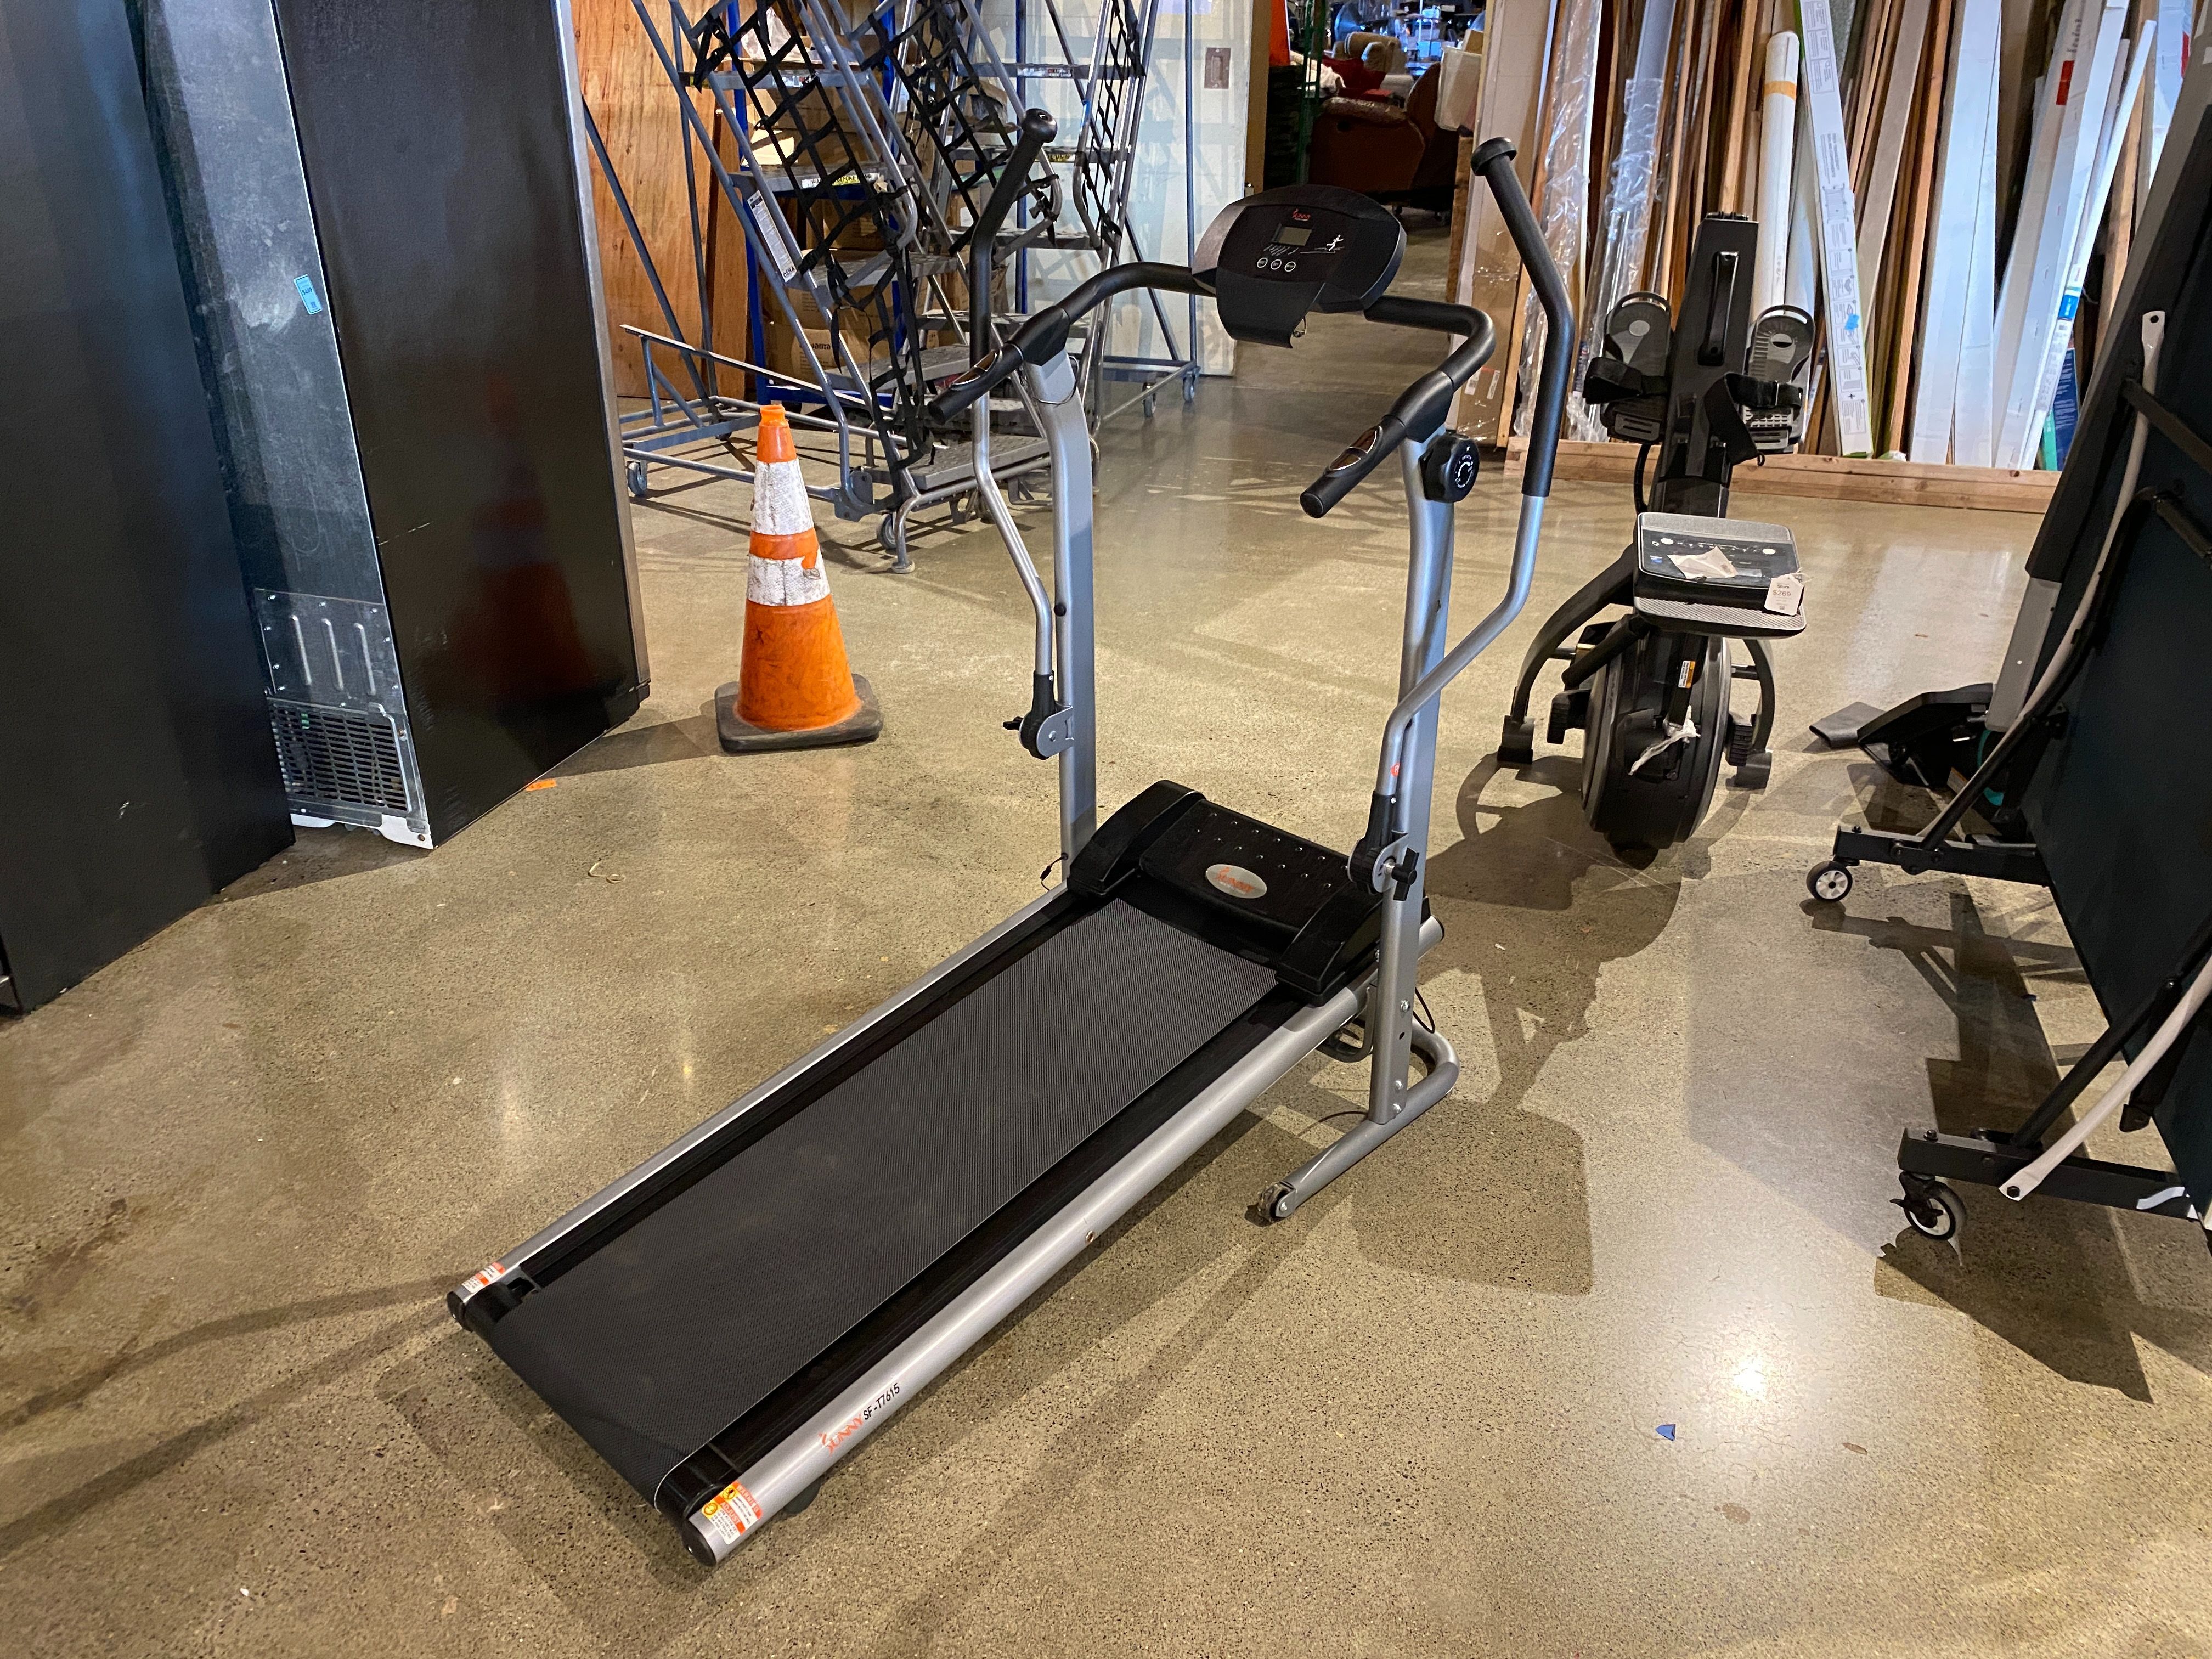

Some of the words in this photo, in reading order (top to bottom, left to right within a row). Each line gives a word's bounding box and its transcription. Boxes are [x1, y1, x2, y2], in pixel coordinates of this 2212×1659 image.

[783, 266, 795, 278] OSHA
[1773, 589, 1791, 597] $269
[864, 1383, 900, 1420] SF-T7615
[721, 1502, 740, 1525] ADJUST
